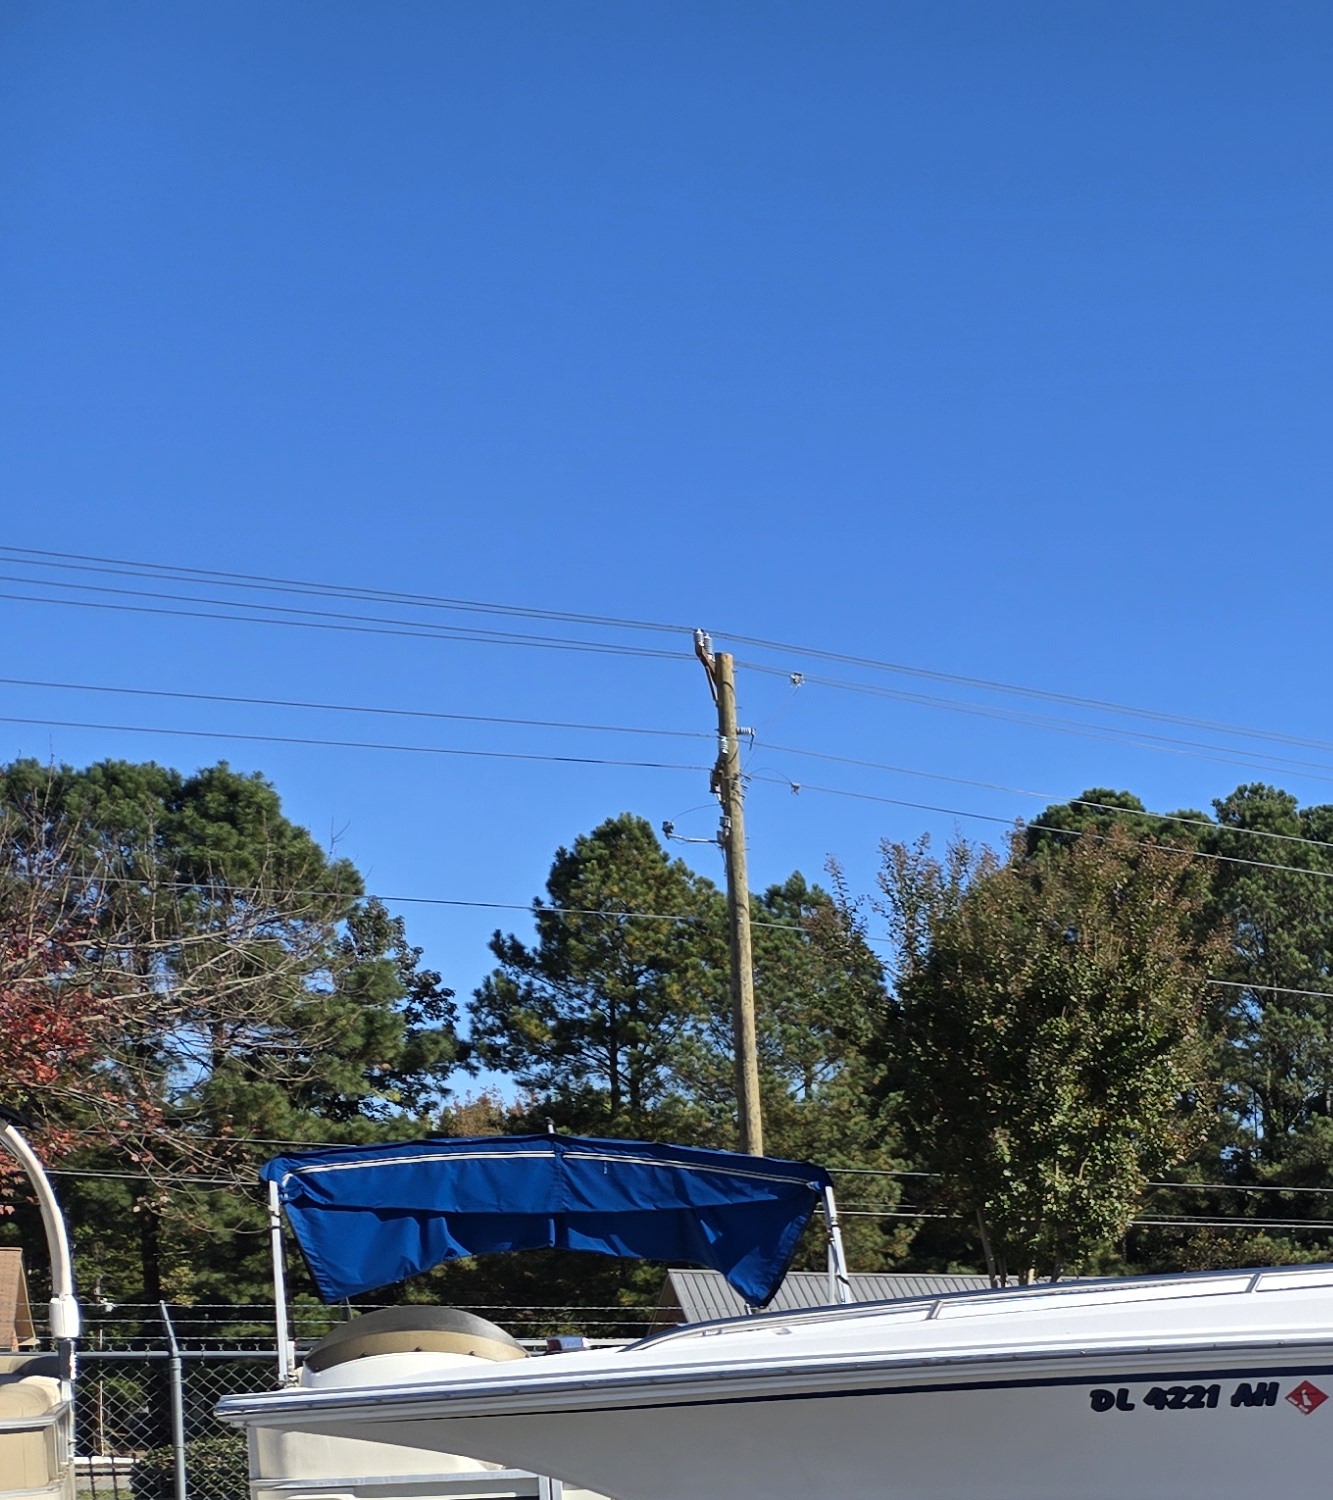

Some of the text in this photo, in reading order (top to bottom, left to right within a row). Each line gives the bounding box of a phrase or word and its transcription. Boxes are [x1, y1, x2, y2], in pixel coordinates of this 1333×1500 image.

[1089, 1388, 1135, 1412] DL
[1142, 1384, 1221, 1410] 4221
[1230, 1382, 1280, 1407] AH
